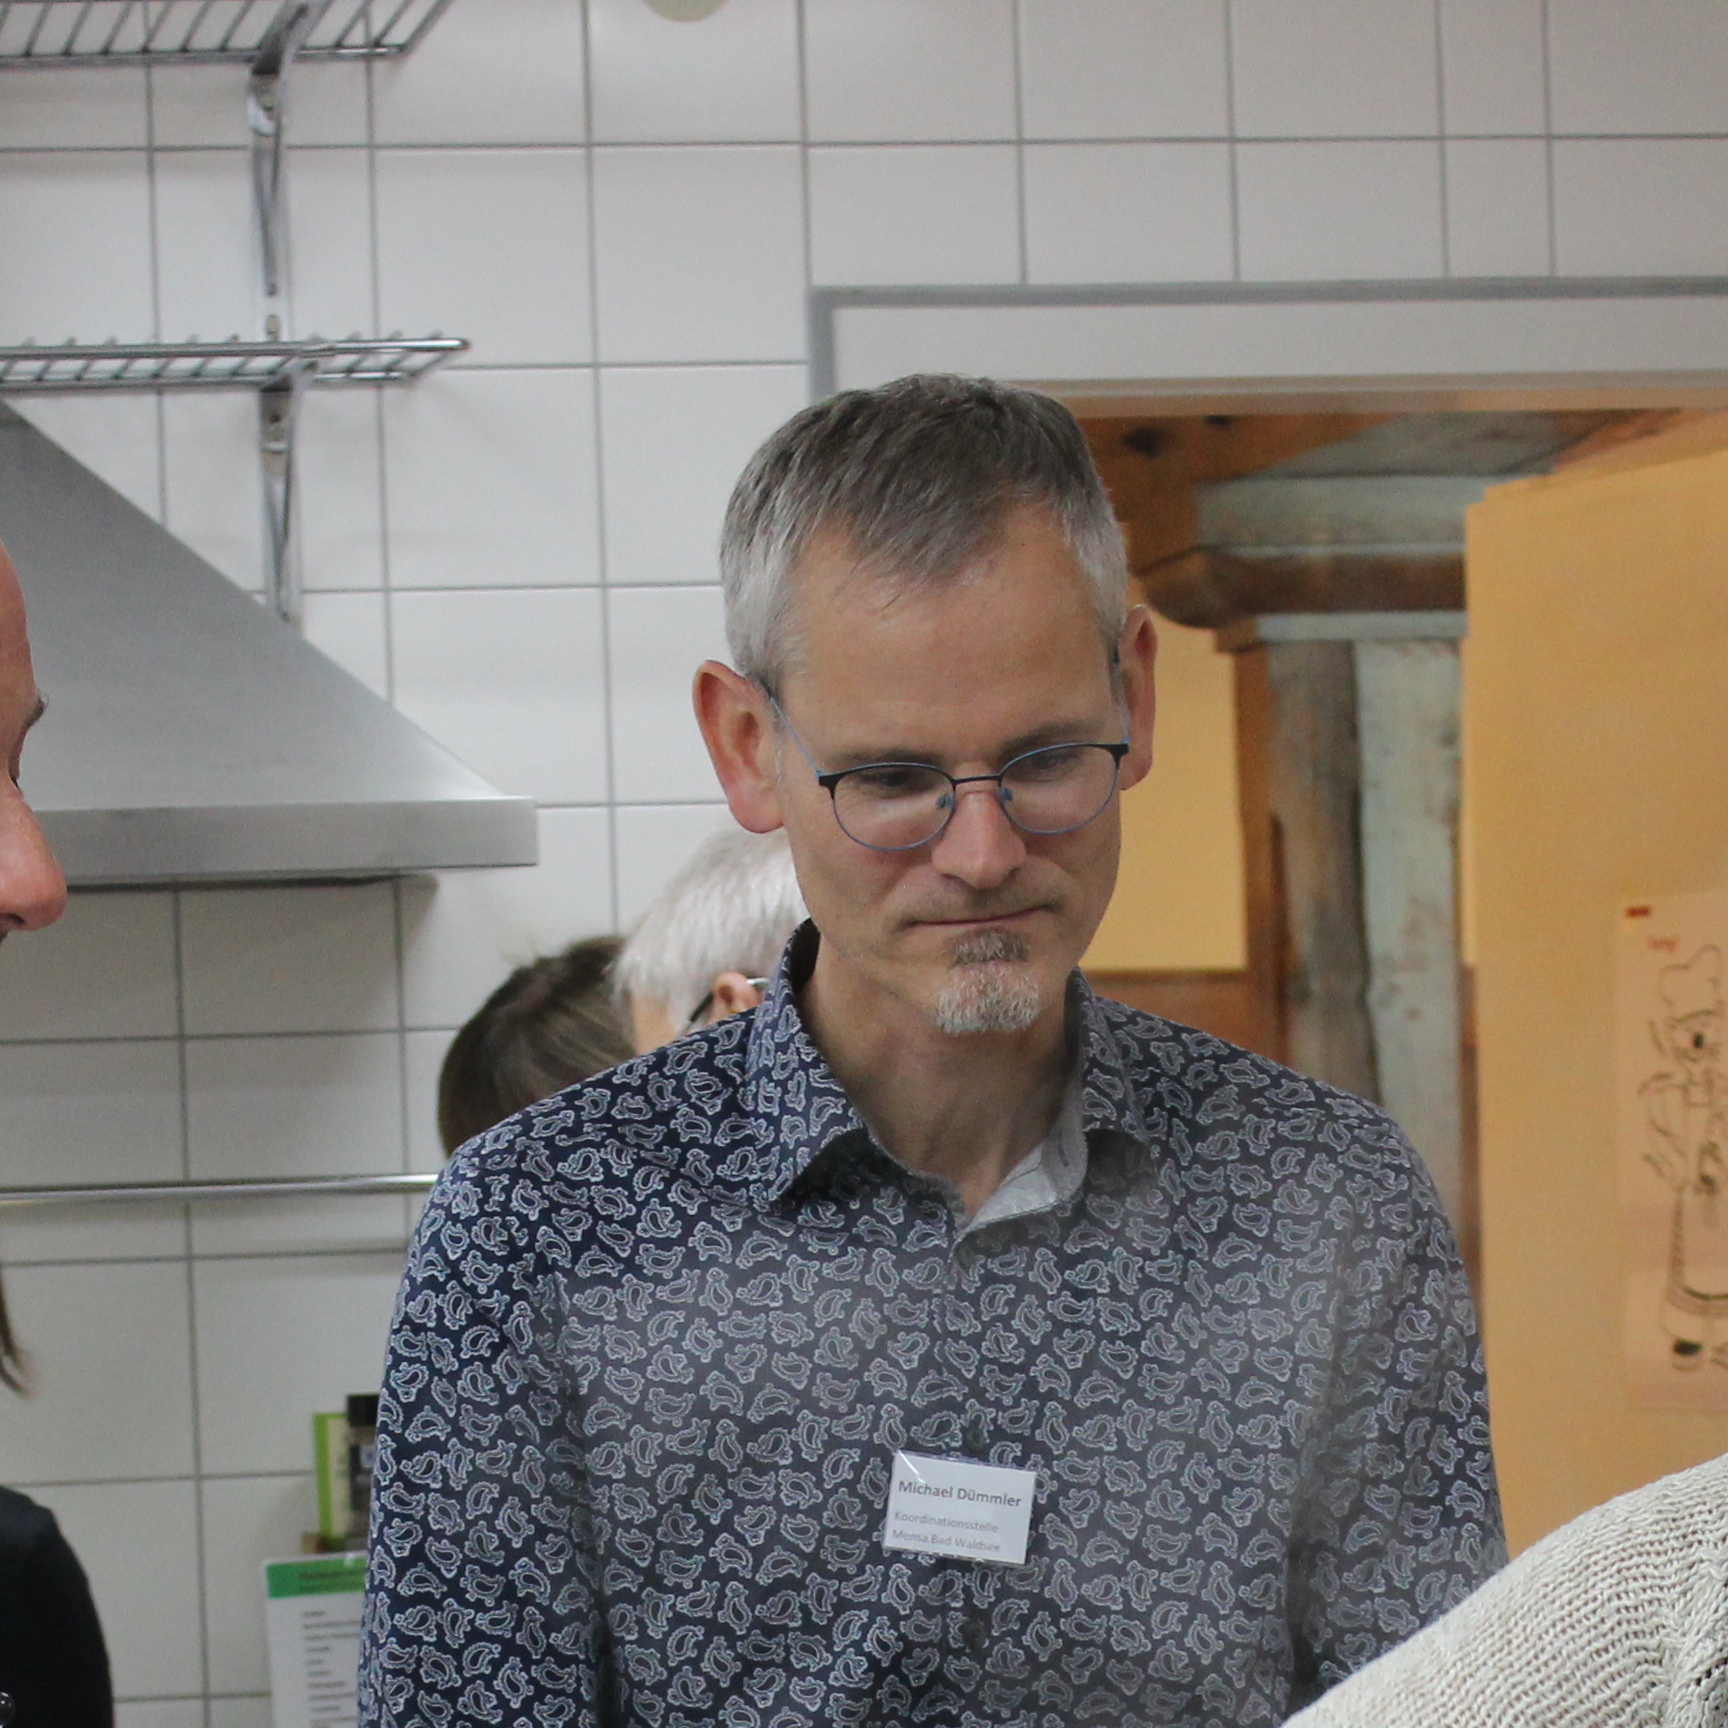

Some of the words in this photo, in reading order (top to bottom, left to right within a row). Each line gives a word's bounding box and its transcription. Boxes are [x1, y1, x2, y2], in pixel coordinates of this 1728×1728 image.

[898, 1481, 953, 1499] Michael
[957, 1487, 1021, 1507] Dümmler
[894, 1511, 999, 1533] Koordinationsstelle
[892, 1529, 929, 1542] Mensa
[931, 1535, 952, 1546] Bad
[955, 1537, 1001, 1552] Waldsee
